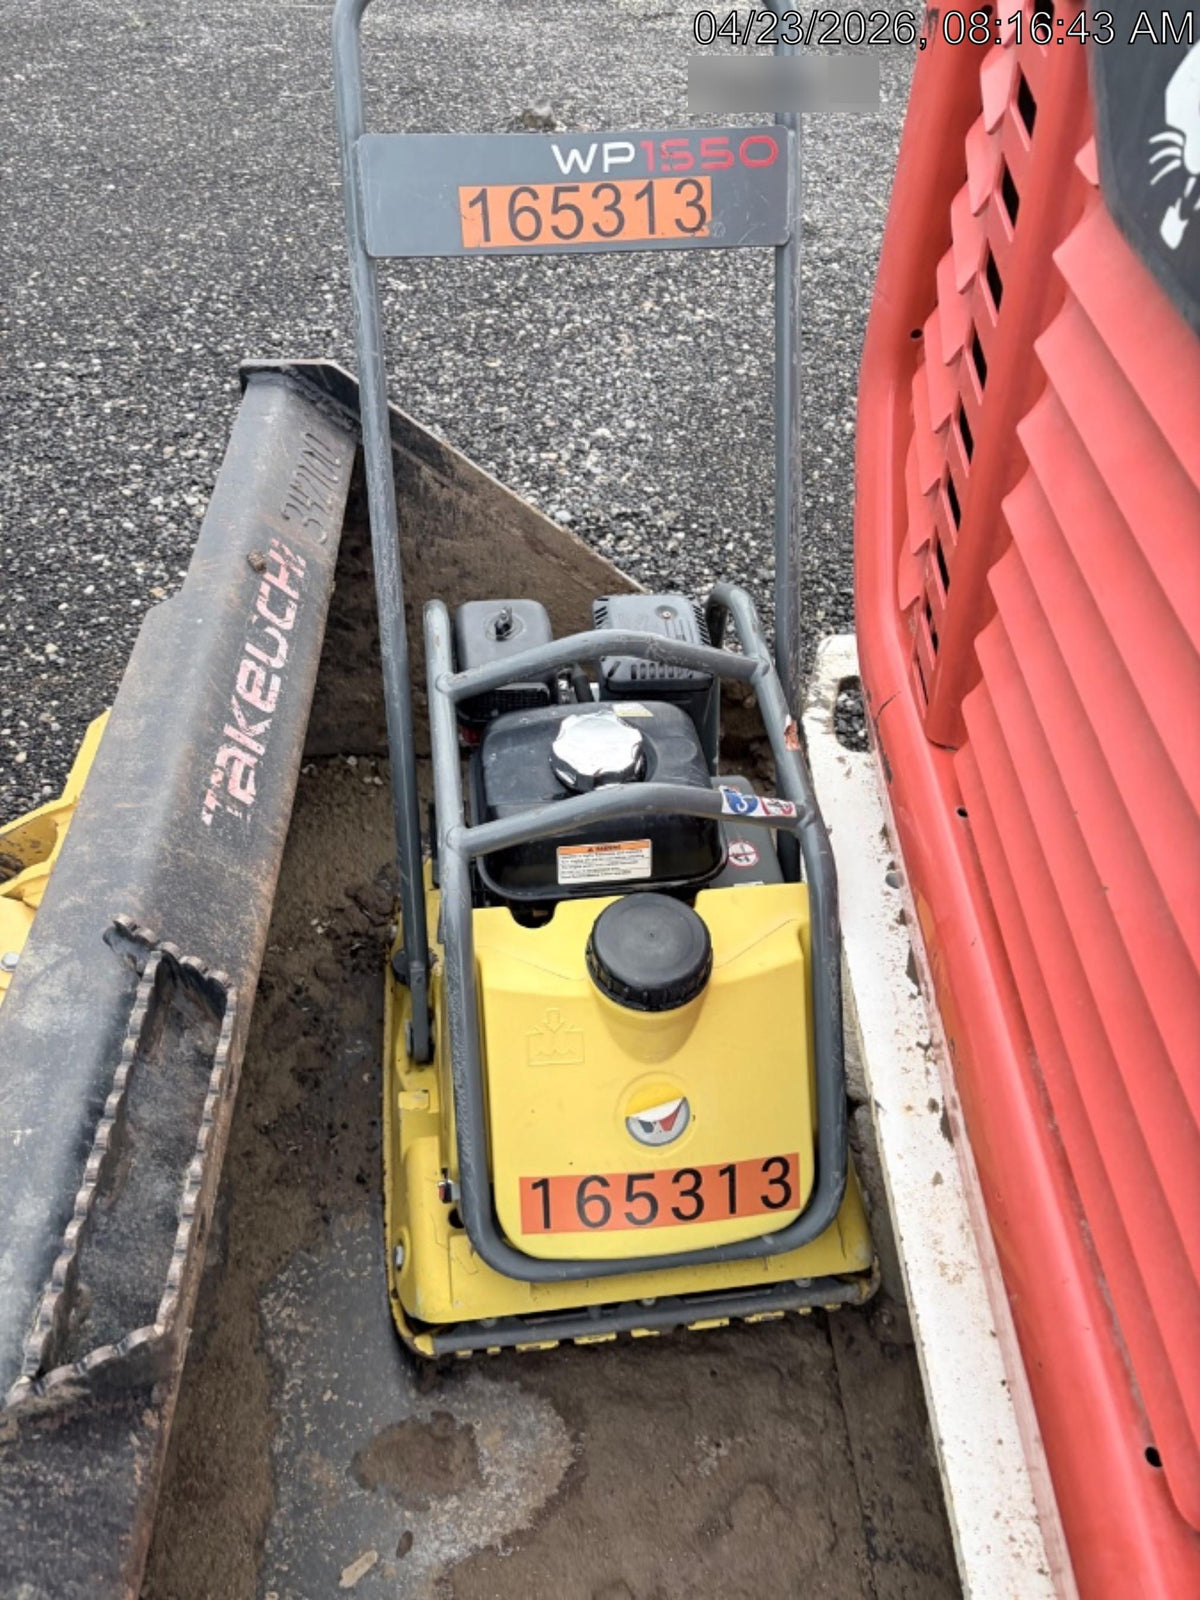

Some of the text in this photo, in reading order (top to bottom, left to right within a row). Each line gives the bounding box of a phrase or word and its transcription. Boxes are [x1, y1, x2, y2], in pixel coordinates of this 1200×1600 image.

[552, 135, 779, 175] WP1550
[468, 179, 708, 243] 165313
[531, 1156, 793, 1230] 165313
